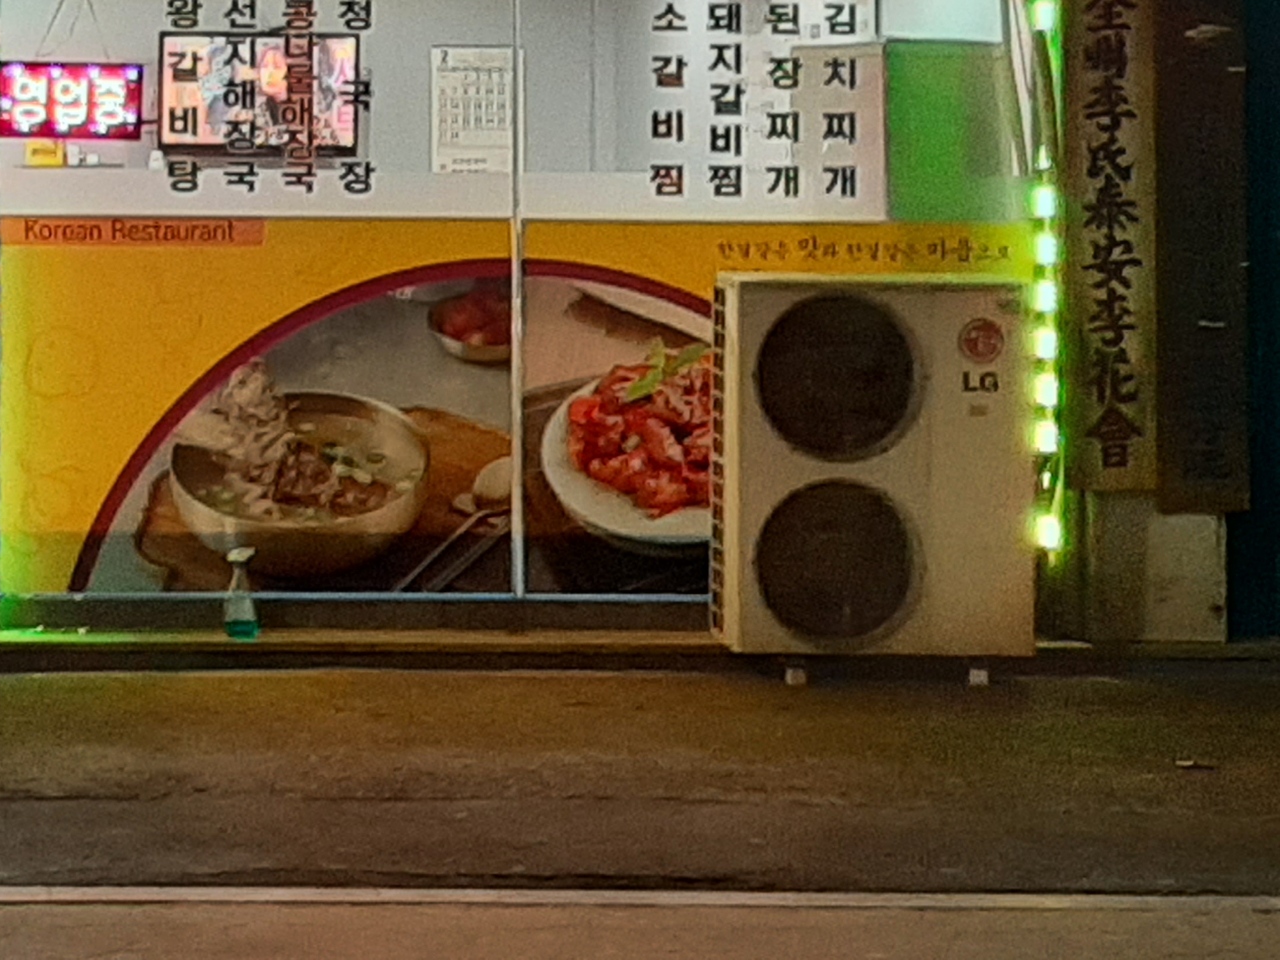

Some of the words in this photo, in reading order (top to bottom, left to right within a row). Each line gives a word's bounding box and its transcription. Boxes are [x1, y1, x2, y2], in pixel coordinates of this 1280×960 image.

[12, 76, 127, 127] 영업중
[649, 3, 688, 197] 소갈비찜
[707, 2, 746, 197] 돼지갈비찜
[765, 3, 802, 198] 된장찌개
[822, 3, 858, 198] 김치찌개
[24, 218, 102, 241] Korean
[111, 218, 235, 242] Restaurant
[963, 371, 999, 393] LG
